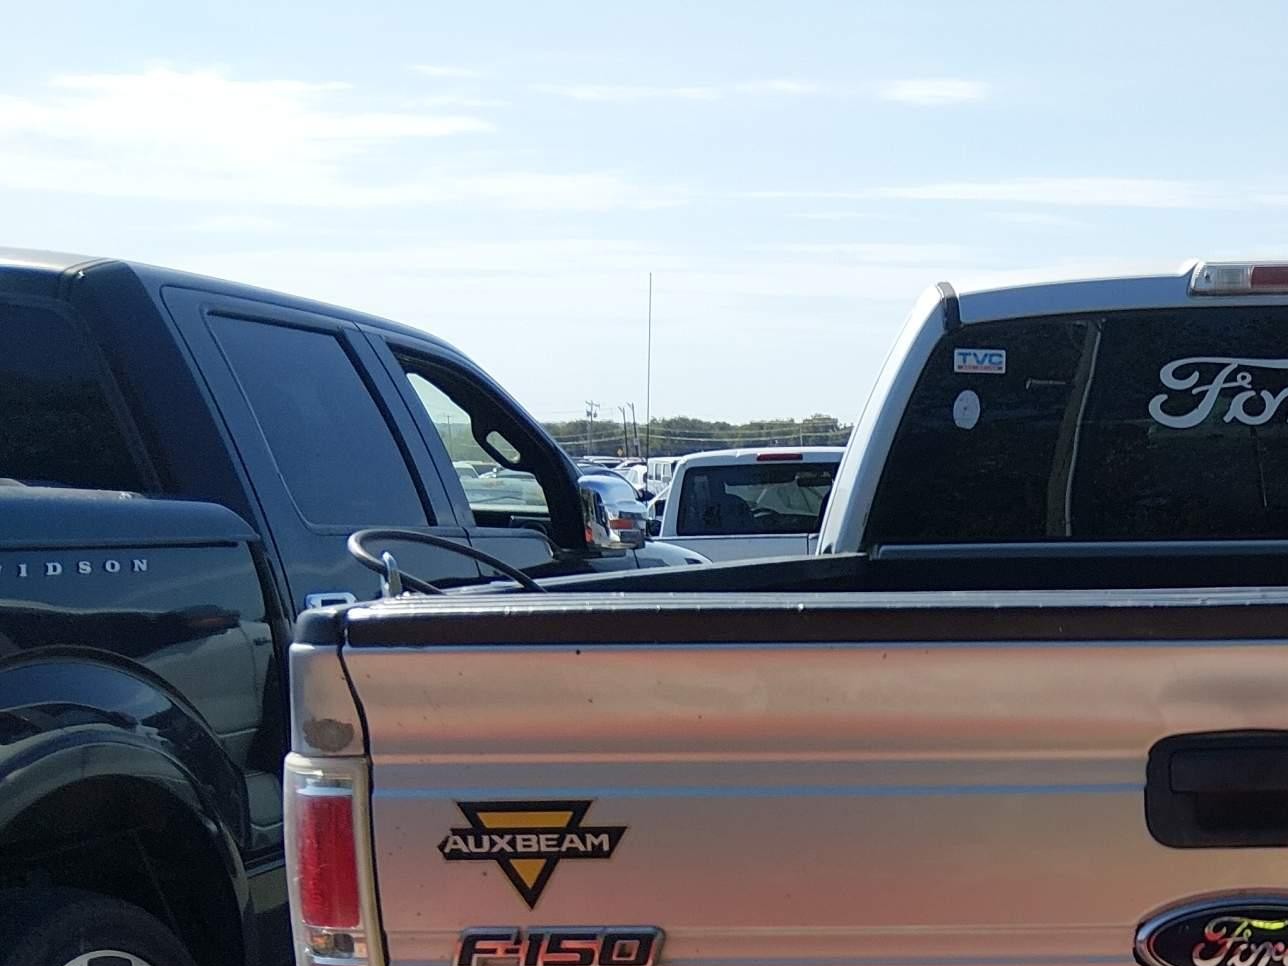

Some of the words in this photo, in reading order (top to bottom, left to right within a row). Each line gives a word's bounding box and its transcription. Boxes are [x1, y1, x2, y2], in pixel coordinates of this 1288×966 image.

[958, 351, 1003, 365] TVC
[0, 559, 148, 577] IDSON
[444, 832, 610, 853] AUXBEAM
